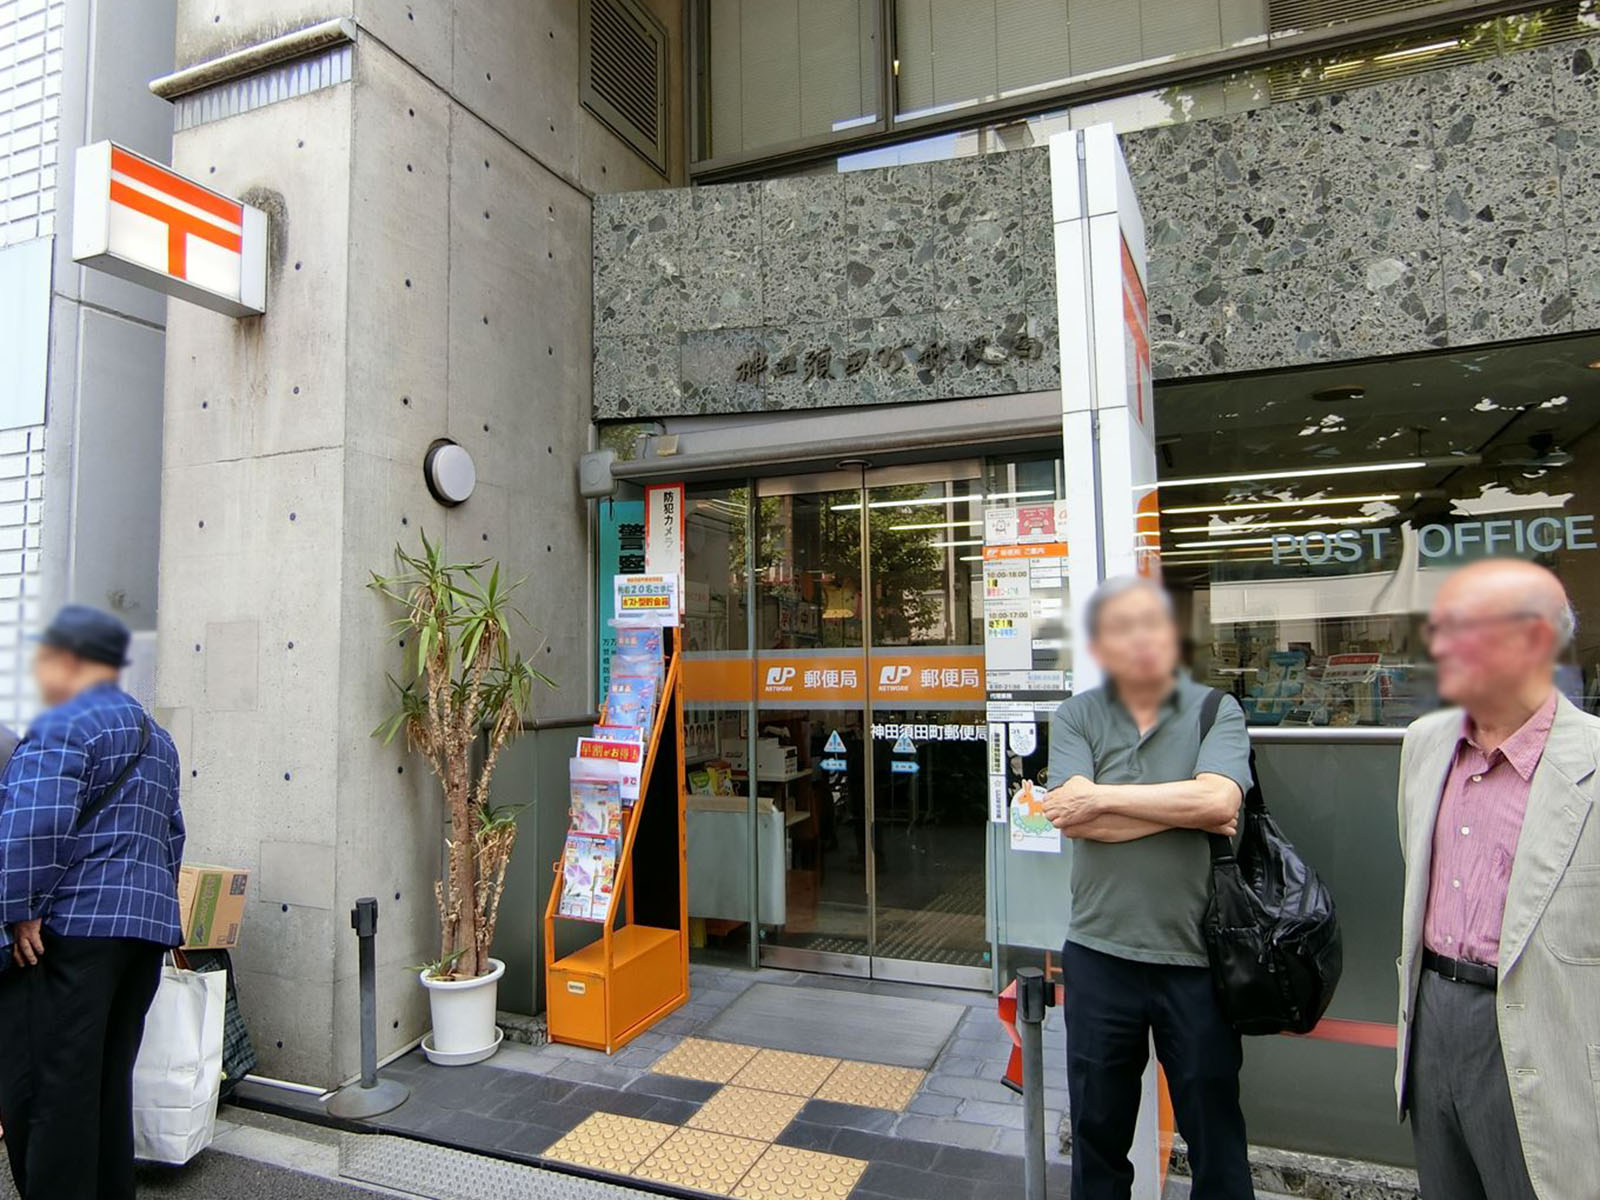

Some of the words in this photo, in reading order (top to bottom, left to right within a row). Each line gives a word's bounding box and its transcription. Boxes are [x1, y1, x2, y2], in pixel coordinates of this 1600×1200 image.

[1271, 527, 1392, 565] POST
[1417, 515, 1598, 558] OFFICE
[804, 669, 857, 689] 郵便局
[921, 668, 979, 689] 郵便局
[871, 723, 988, 741] 神田須田町郵便局
